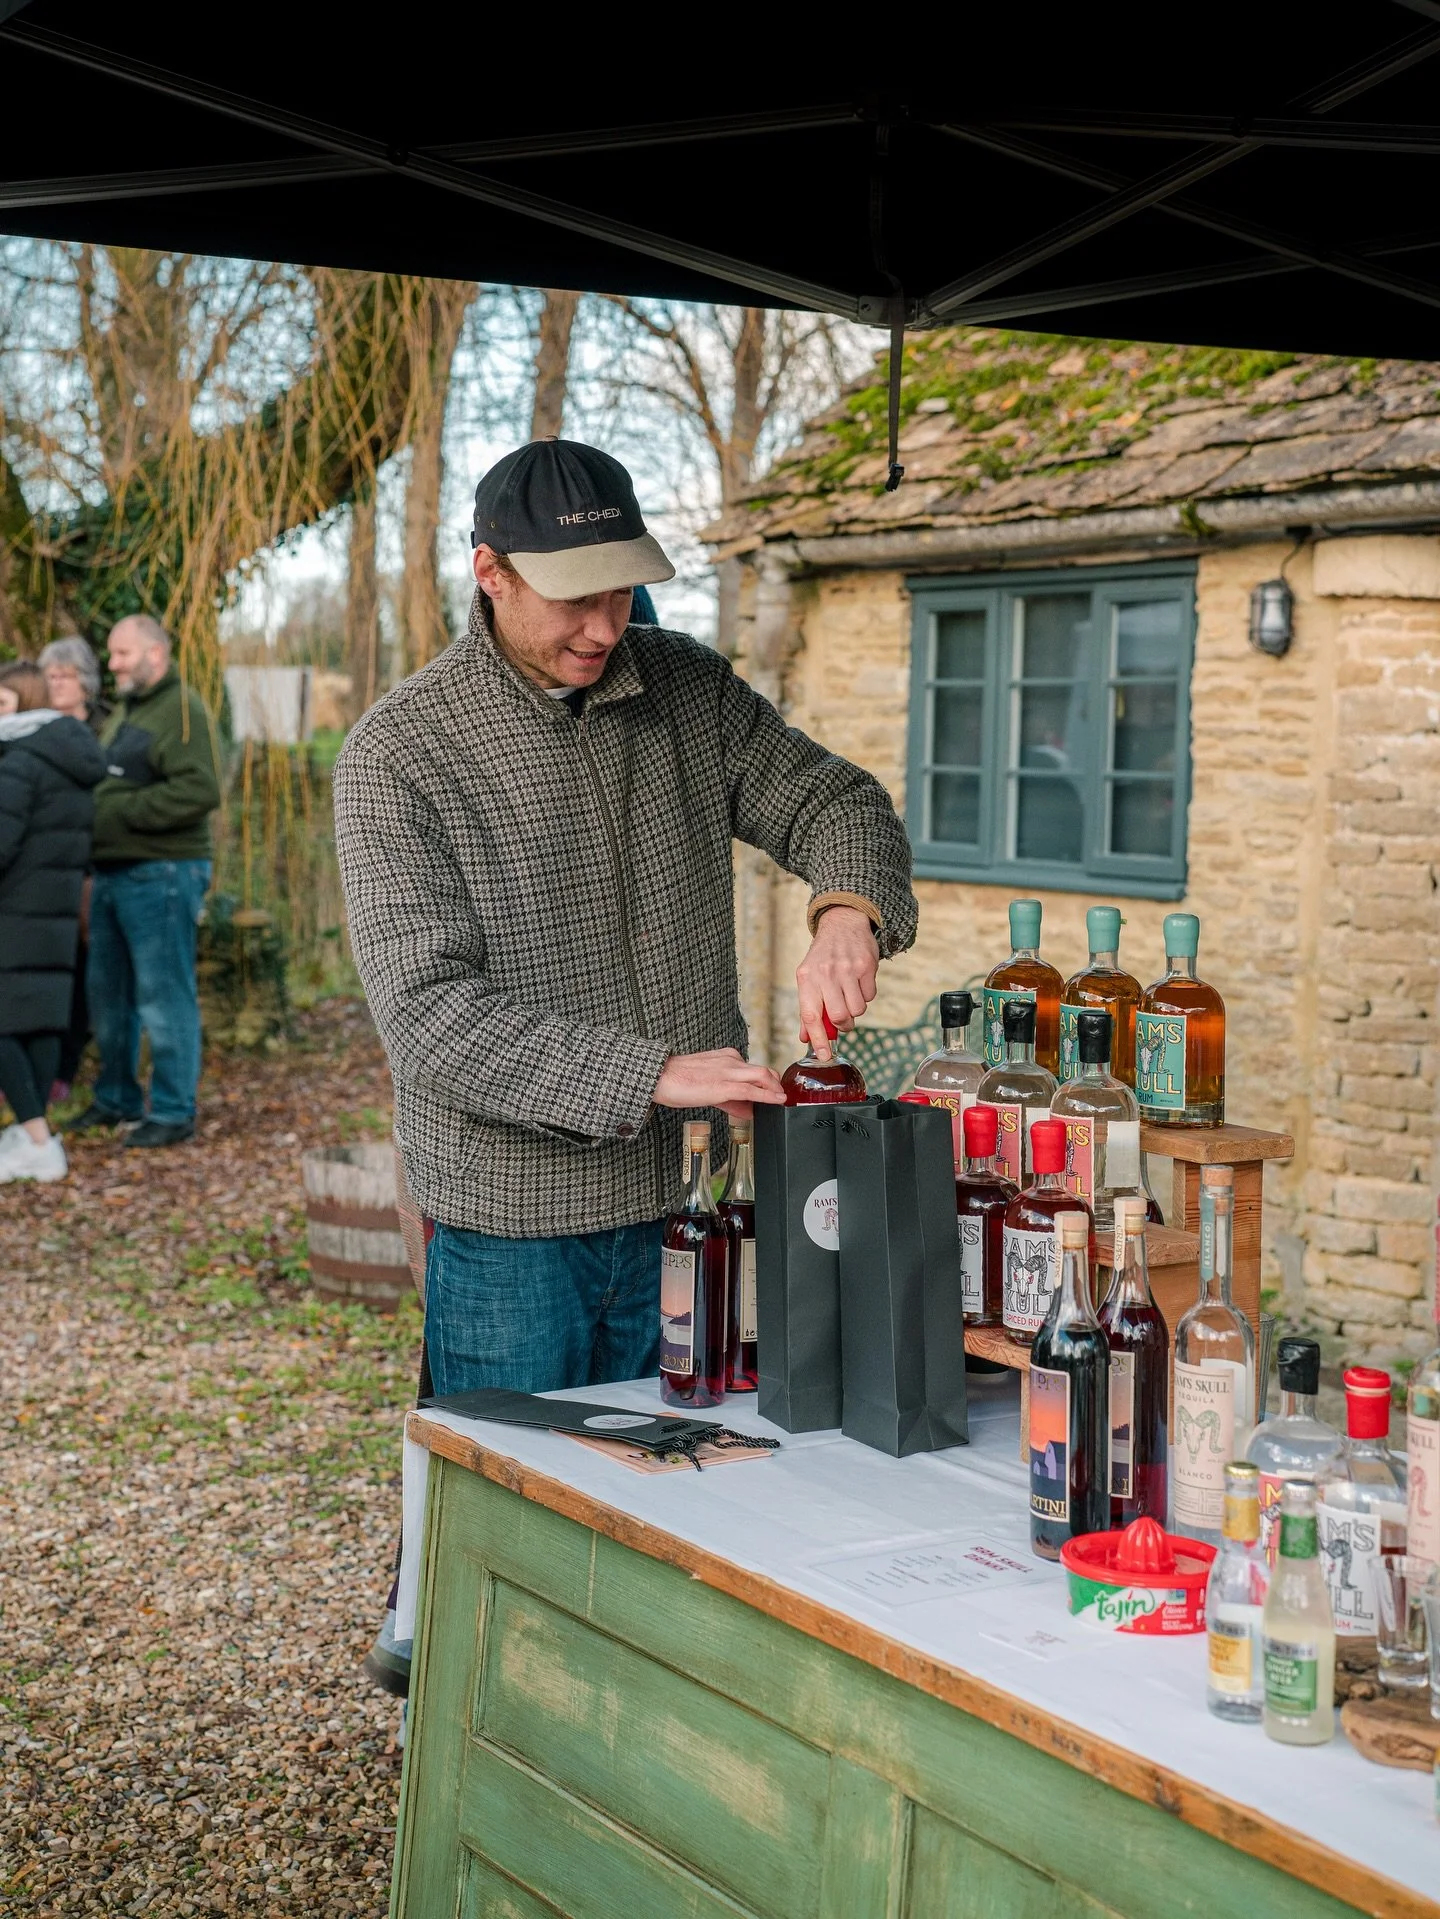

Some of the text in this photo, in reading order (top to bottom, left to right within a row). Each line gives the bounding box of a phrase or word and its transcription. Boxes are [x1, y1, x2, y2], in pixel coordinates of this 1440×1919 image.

[556, 512, 586, 526] THE
[1136, 1019, 1182, 1044] AM'S
[1114, 1223, 1124, 1263] CRIPPS
[1203, 1224, 1212, 1267] BLANCO
[1195, 1379, 1230, 1395] SKULL
[1178, 1391, 1215, 1404] TEQUILA
[1178, 1467, 1213, 1481] BLANCO
[1327, 1517, 1376, 1552] M'S
